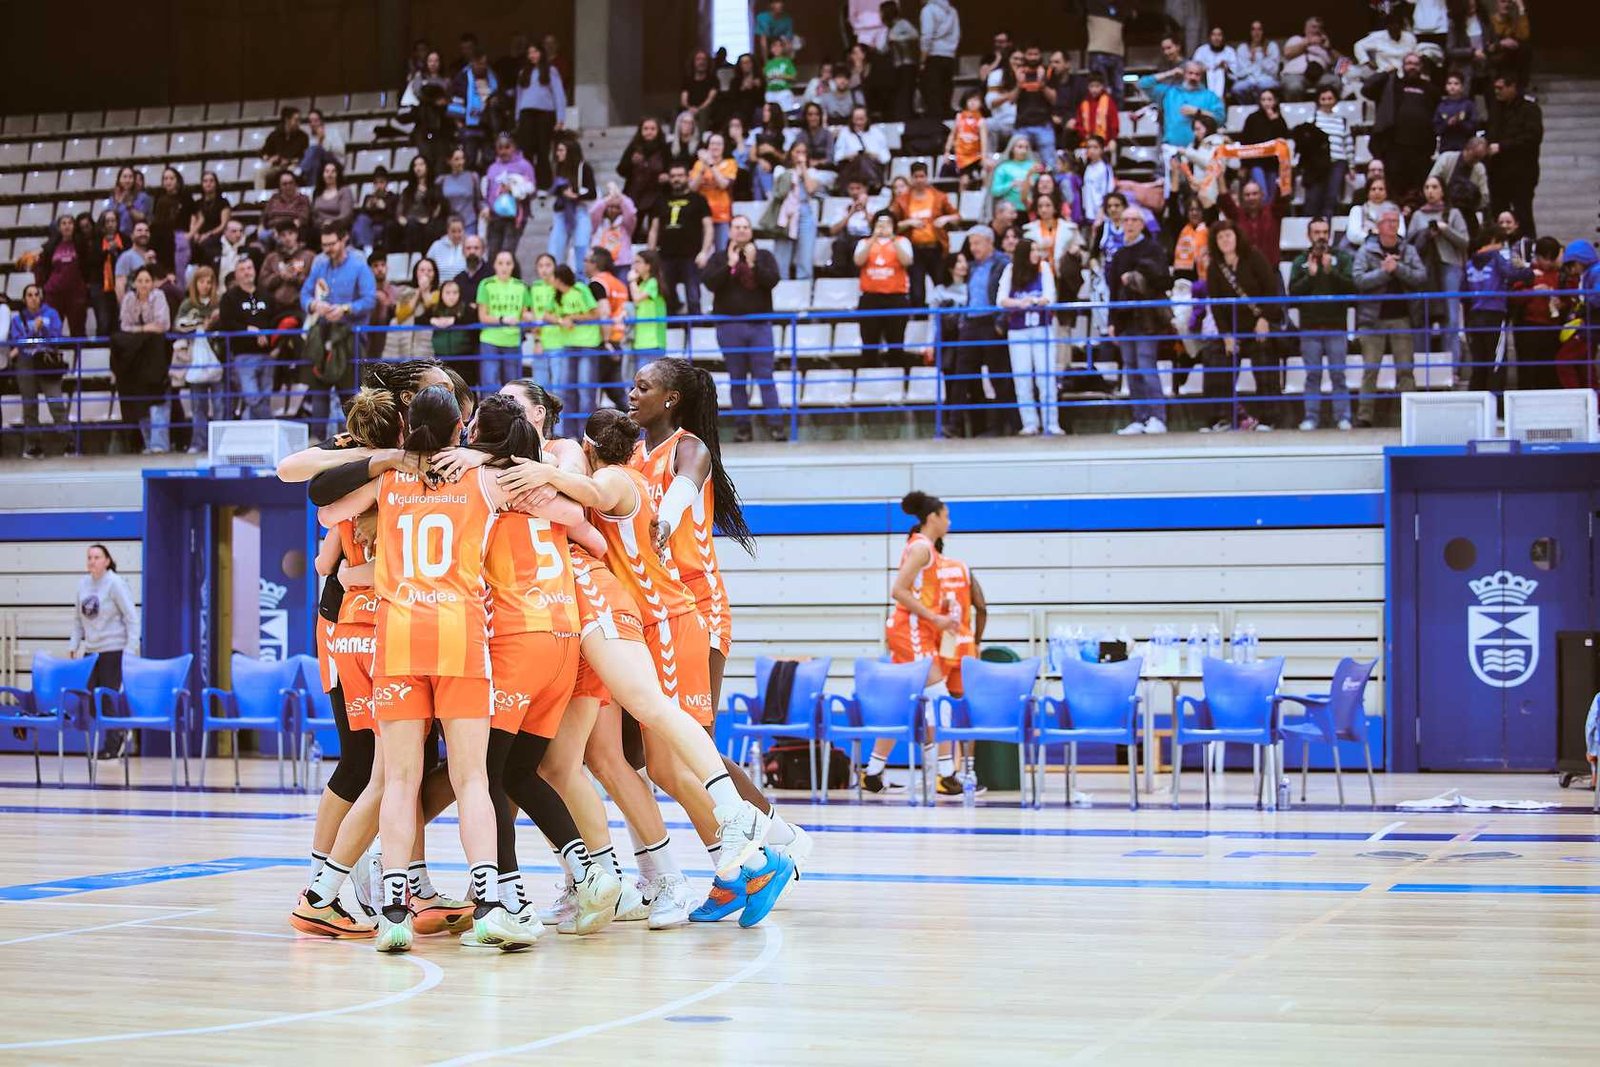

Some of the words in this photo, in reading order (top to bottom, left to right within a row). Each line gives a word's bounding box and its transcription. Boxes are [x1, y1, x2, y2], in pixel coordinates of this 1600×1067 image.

[397, 513, 454, 578] 10
[528, 517, 564, 580] 5
[407, 588, 457, 605] Midea
